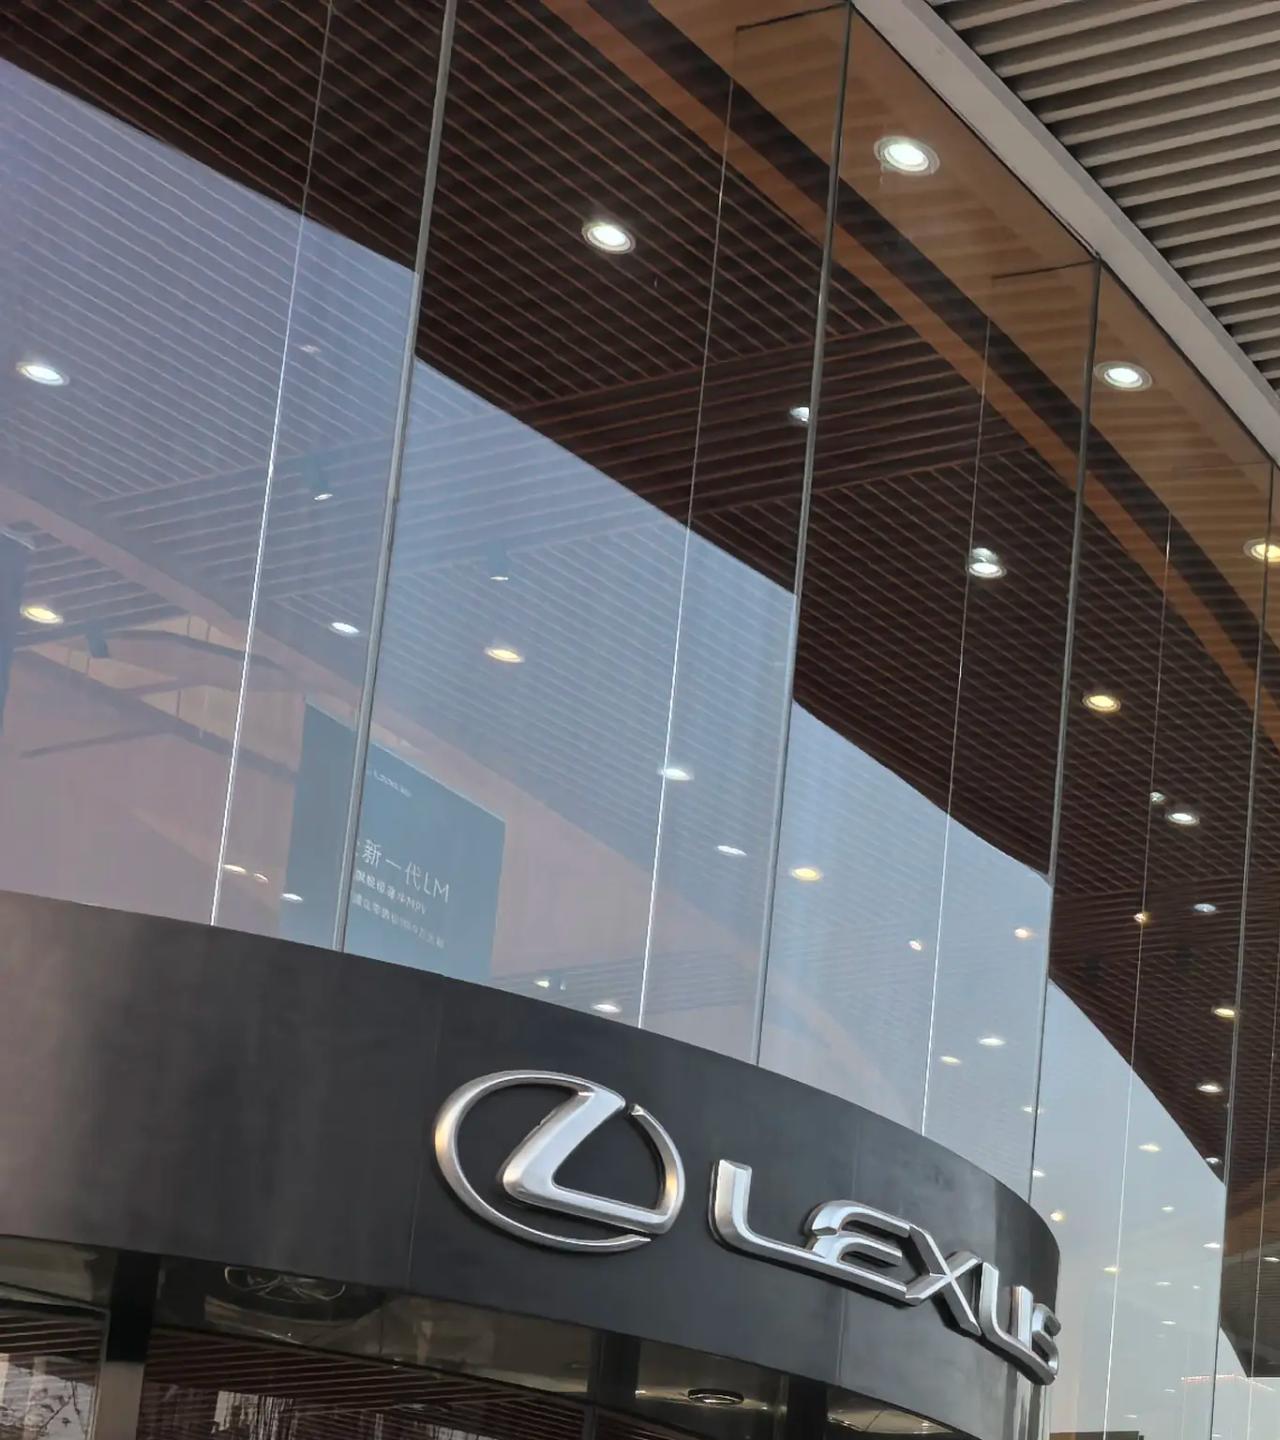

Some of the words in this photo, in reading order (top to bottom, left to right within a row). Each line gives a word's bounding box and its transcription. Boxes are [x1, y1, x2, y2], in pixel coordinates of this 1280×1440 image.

[354, 838, 449, 904] 新一代LM
[709, 1158, 1062, 1386] LEXUS
